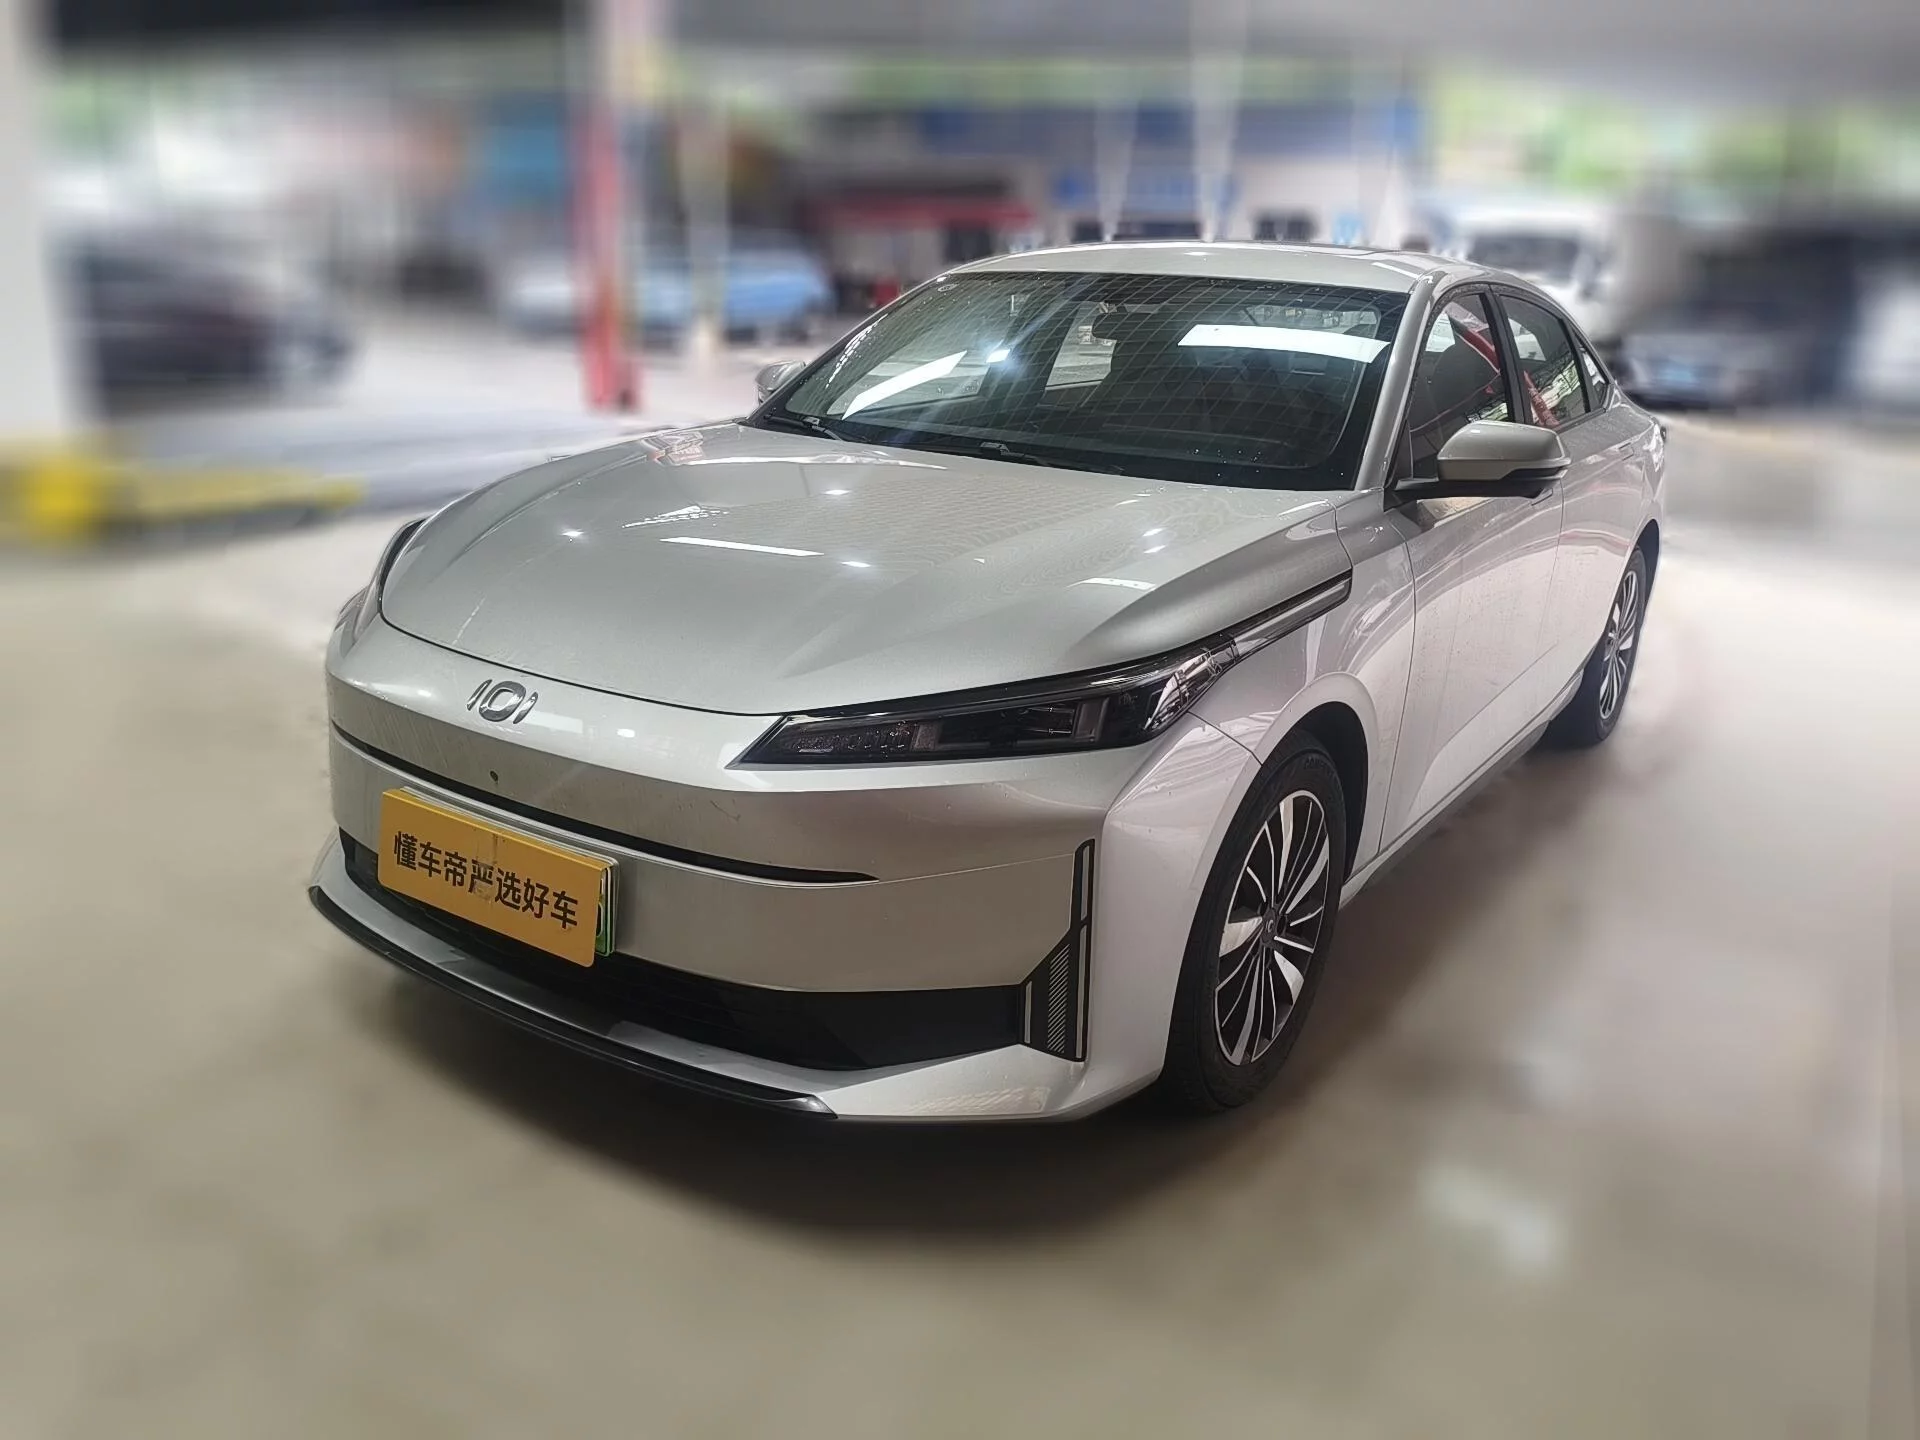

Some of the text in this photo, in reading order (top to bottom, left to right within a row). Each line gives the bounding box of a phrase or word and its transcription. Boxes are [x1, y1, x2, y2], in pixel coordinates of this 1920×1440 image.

[394, 831, 578, 929] 懂车帝严选好车
